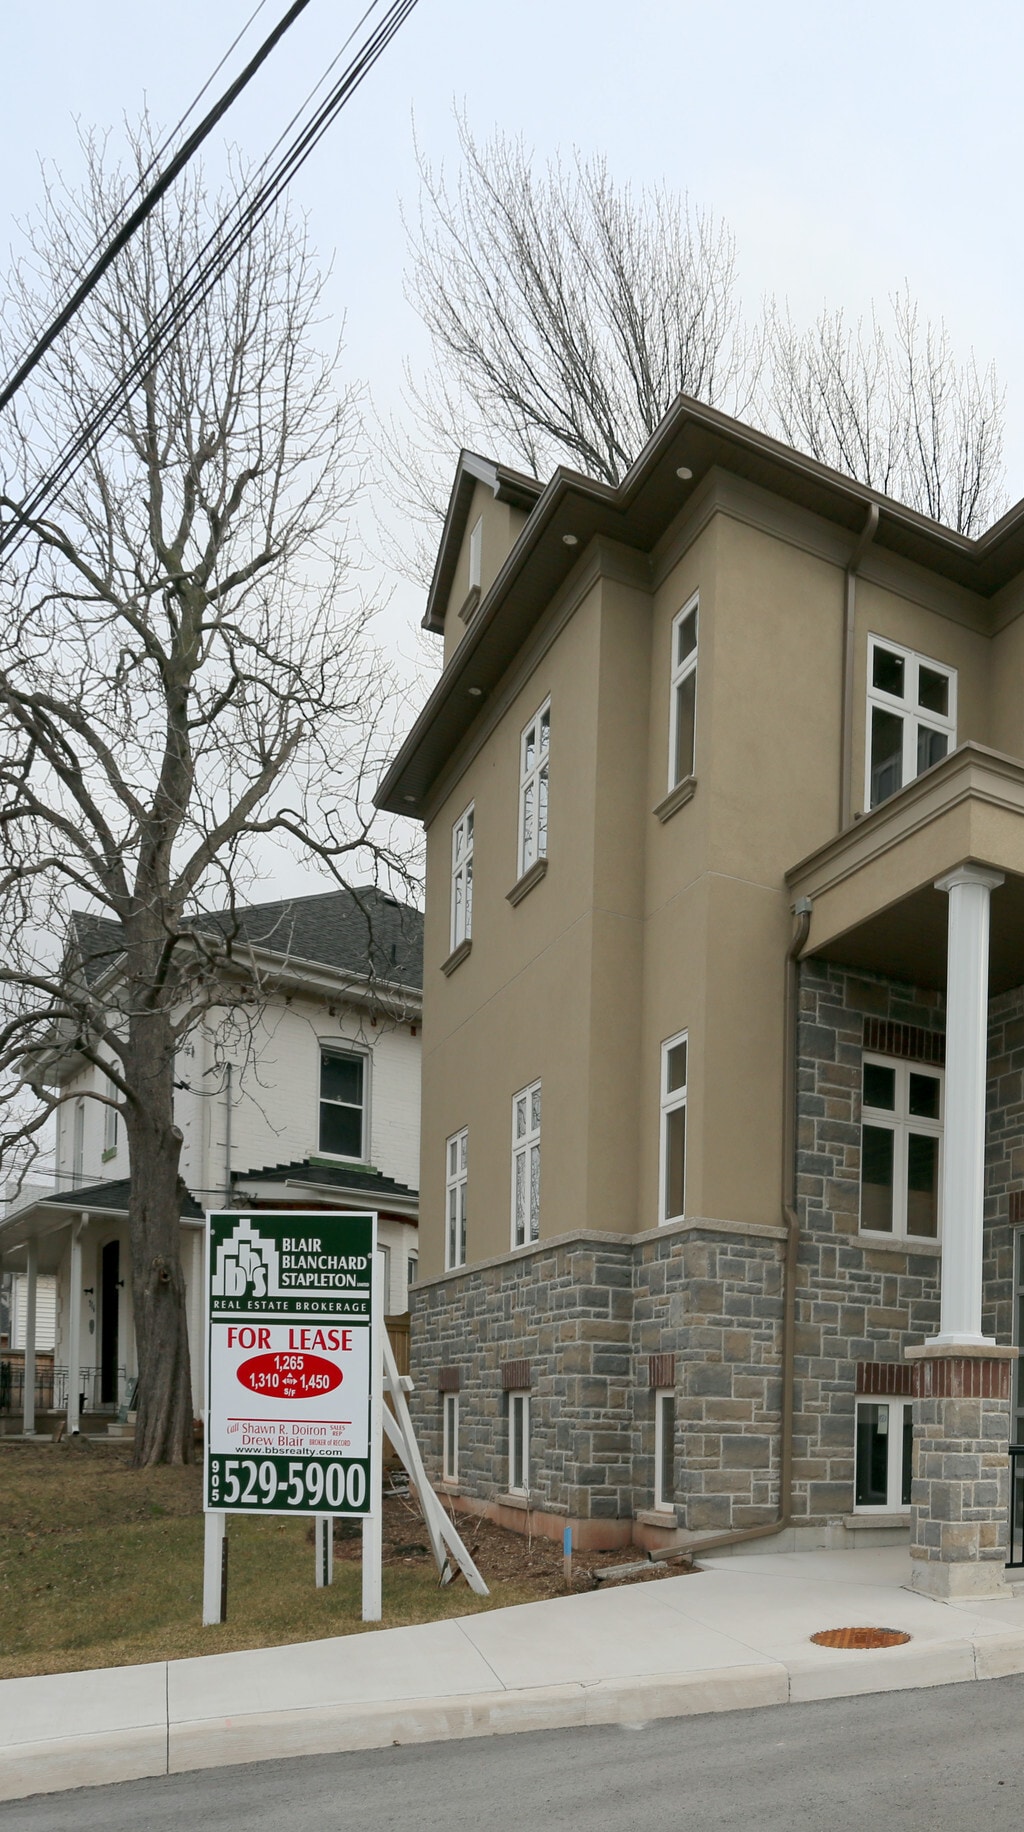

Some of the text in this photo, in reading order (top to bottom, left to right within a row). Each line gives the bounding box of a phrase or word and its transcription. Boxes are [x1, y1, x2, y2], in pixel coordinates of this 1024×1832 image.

[282, 1238, 322, 1253] BLAIR
[282, 1255, 367, 1270] BLANCHARD
[281, 1273, 356, 1287] STAPLETON
[214, 1300, 367, 1312] REAL ESTATE BROKERAGE
[227, 1327, 353, 1351] FOR LEASE
[274, 1355, 304, 1372] 1,265
[249, 1372, 279, 1390] 1,310
[300, 1373, 330, 1391] 1,450
[283, 1388, 296, 1397] S/F
[242, 1423, 275, 1434] Shawn
[279, 1424, 288, 1435] R.
[292, 1424, 327, 1436] Doiron
[242, 1434, 274, 1446] Drew
[277, 1435, 304, 1447] Blair
[309, 1438, 327, 1446] BROKER
[333, 1439, 351, 1447] RECORD
[235, 1446, 343, 1458] www.bbsrealty.com
[223, 1460, 366, 1508] 529-5900
